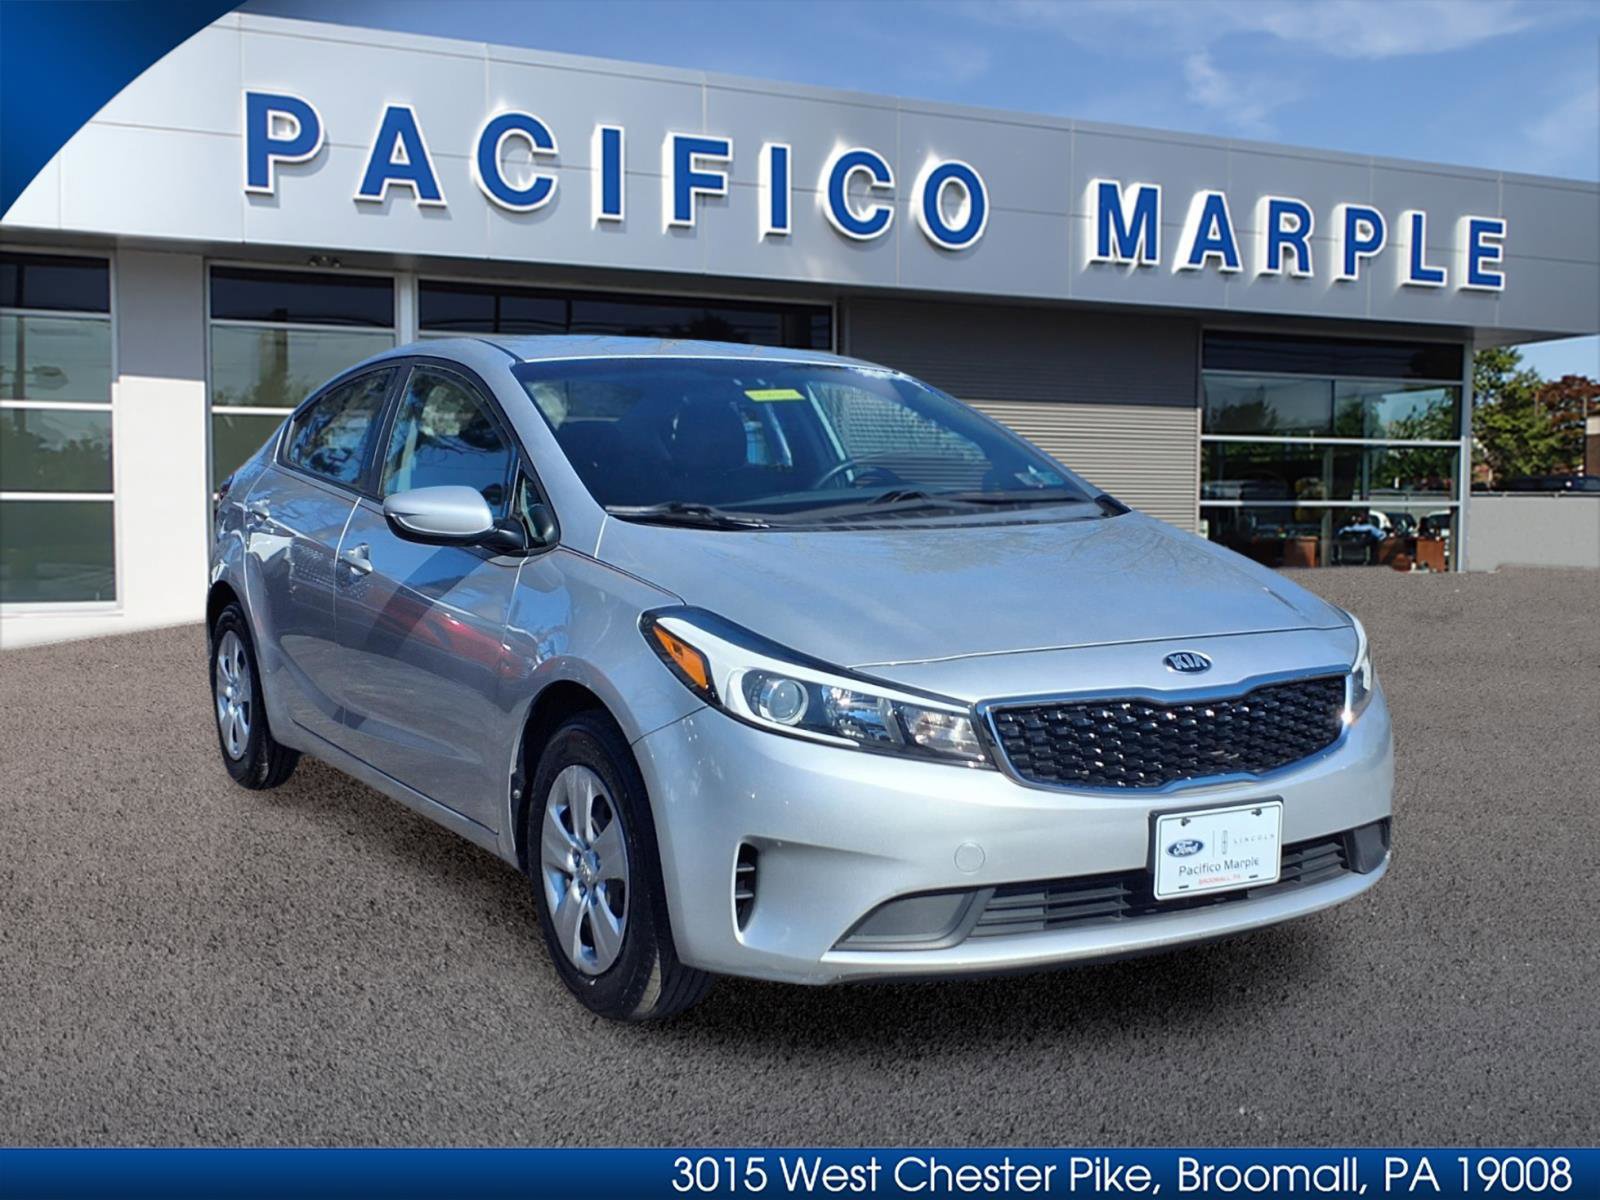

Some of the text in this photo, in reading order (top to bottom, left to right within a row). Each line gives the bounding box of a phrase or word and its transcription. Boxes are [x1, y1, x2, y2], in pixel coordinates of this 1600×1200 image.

[243, 88, 1507, 293] PACIFICO MARPLE
[1168, 653, 1208, 669] KIA
[1178, 856, 1260, 877] Pacifico Marple
